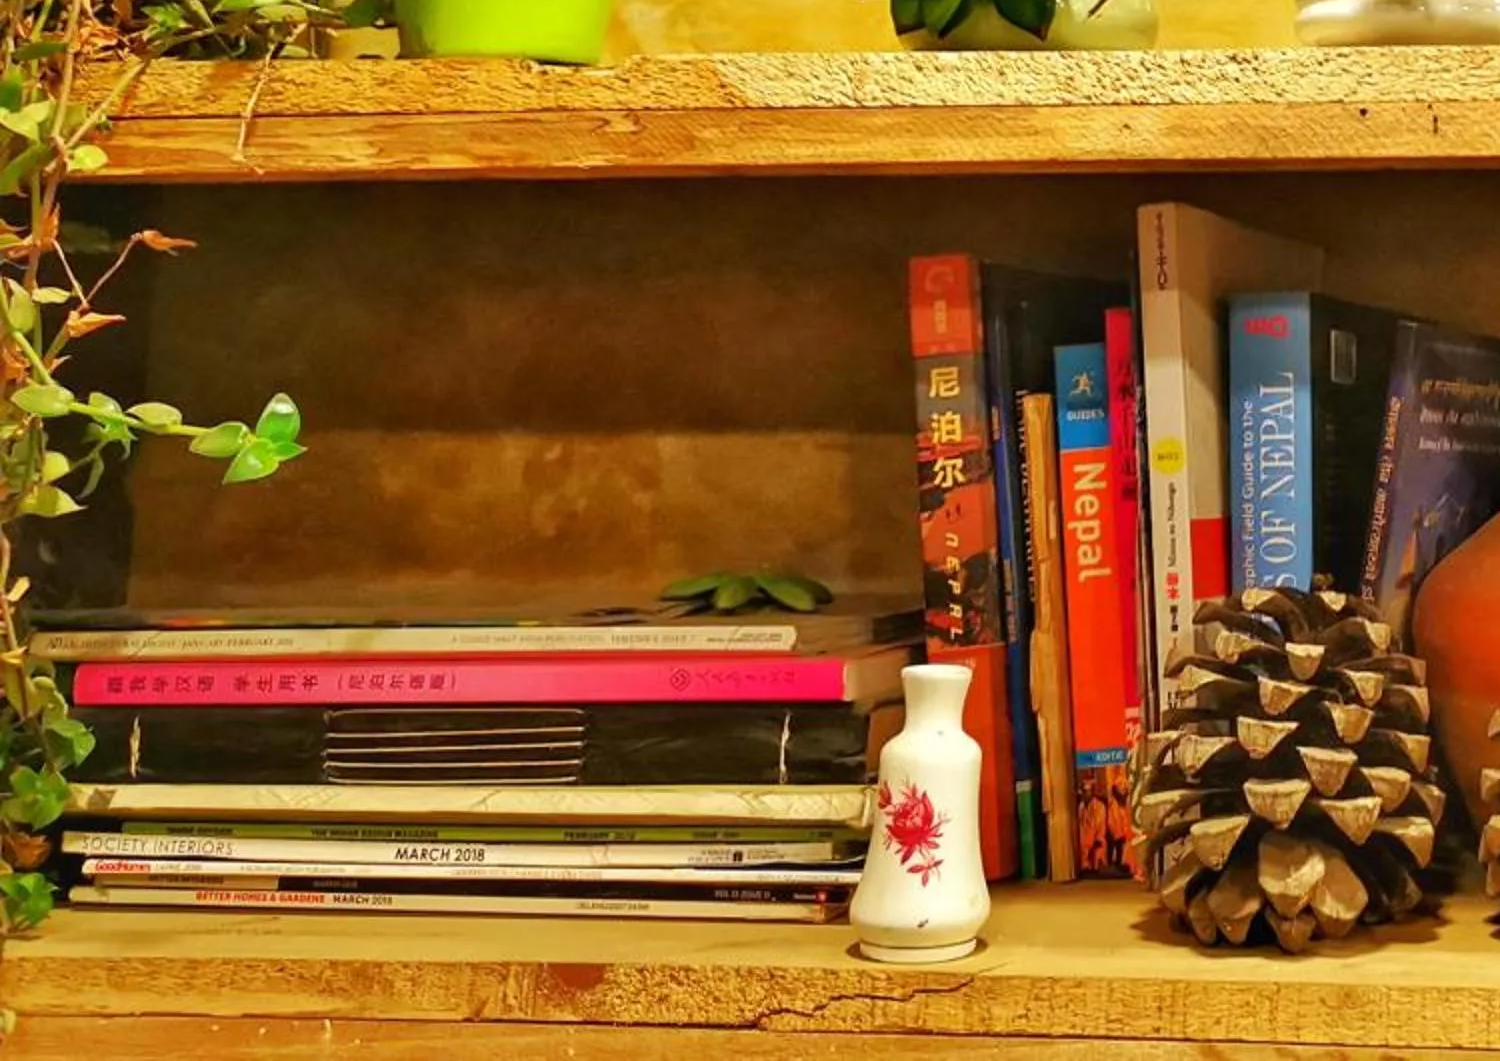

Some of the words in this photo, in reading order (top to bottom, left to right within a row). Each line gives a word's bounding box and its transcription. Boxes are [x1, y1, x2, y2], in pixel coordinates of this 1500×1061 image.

[929, 365, 966, 488] 尼泊尔
[1241, 400, 1254, 421] the
[1242, 429, 1255, 448] to
[1258, 371, 1296, 501] NEPAL
[1241, 457, 1255, 498] Guide
[1066, 461, 1112, 584] Nepal
[1241, 503, 1255, 540] Field
[1259, 510, 1297, 565] OF
[81, 835, 147, 852] SOCIETY
[152, 839, 234, 856] INTERIORS
[395, 847, 451, 861] MARCH
[454, 847, 486, 862] 2018
[195, 890, 232, 901] BETTER
[279, 893, 325, 904] GARDENS
[332, 895, 370, 905] MARCH
